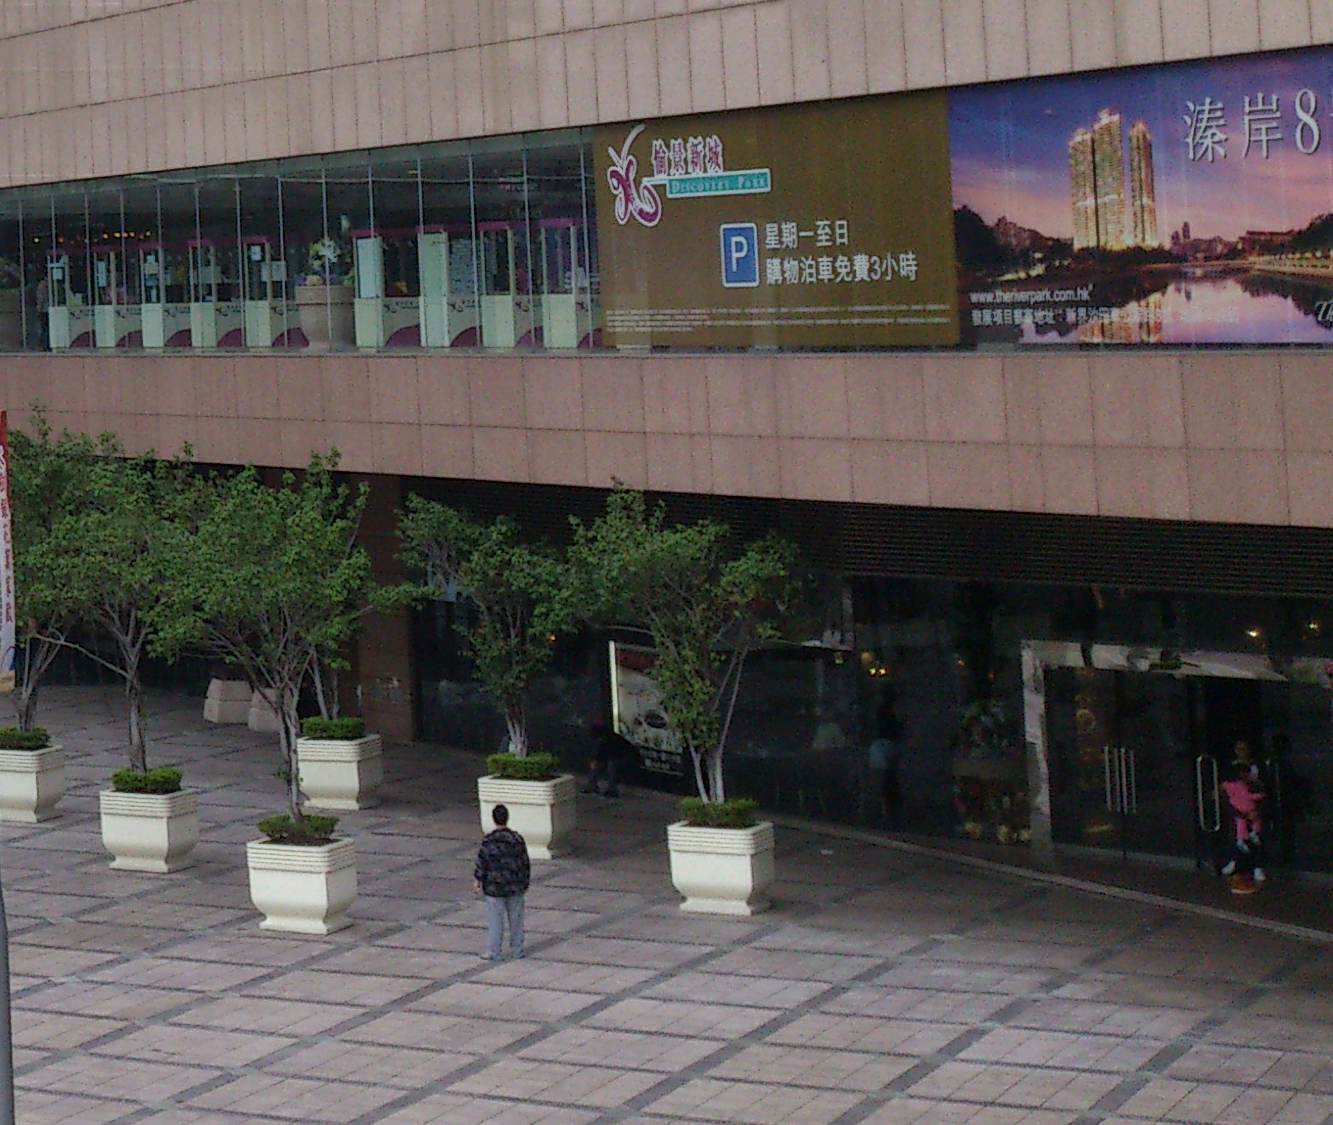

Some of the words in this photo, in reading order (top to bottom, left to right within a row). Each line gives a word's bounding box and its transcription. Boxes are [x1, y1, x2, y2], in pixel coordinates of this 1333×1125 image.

[1183, 87, 1333, 162] 溱岸8
[764, 220, 849, 250] 星期一至日
[765, 251, 919, 285] 購物泊車免費3小時
